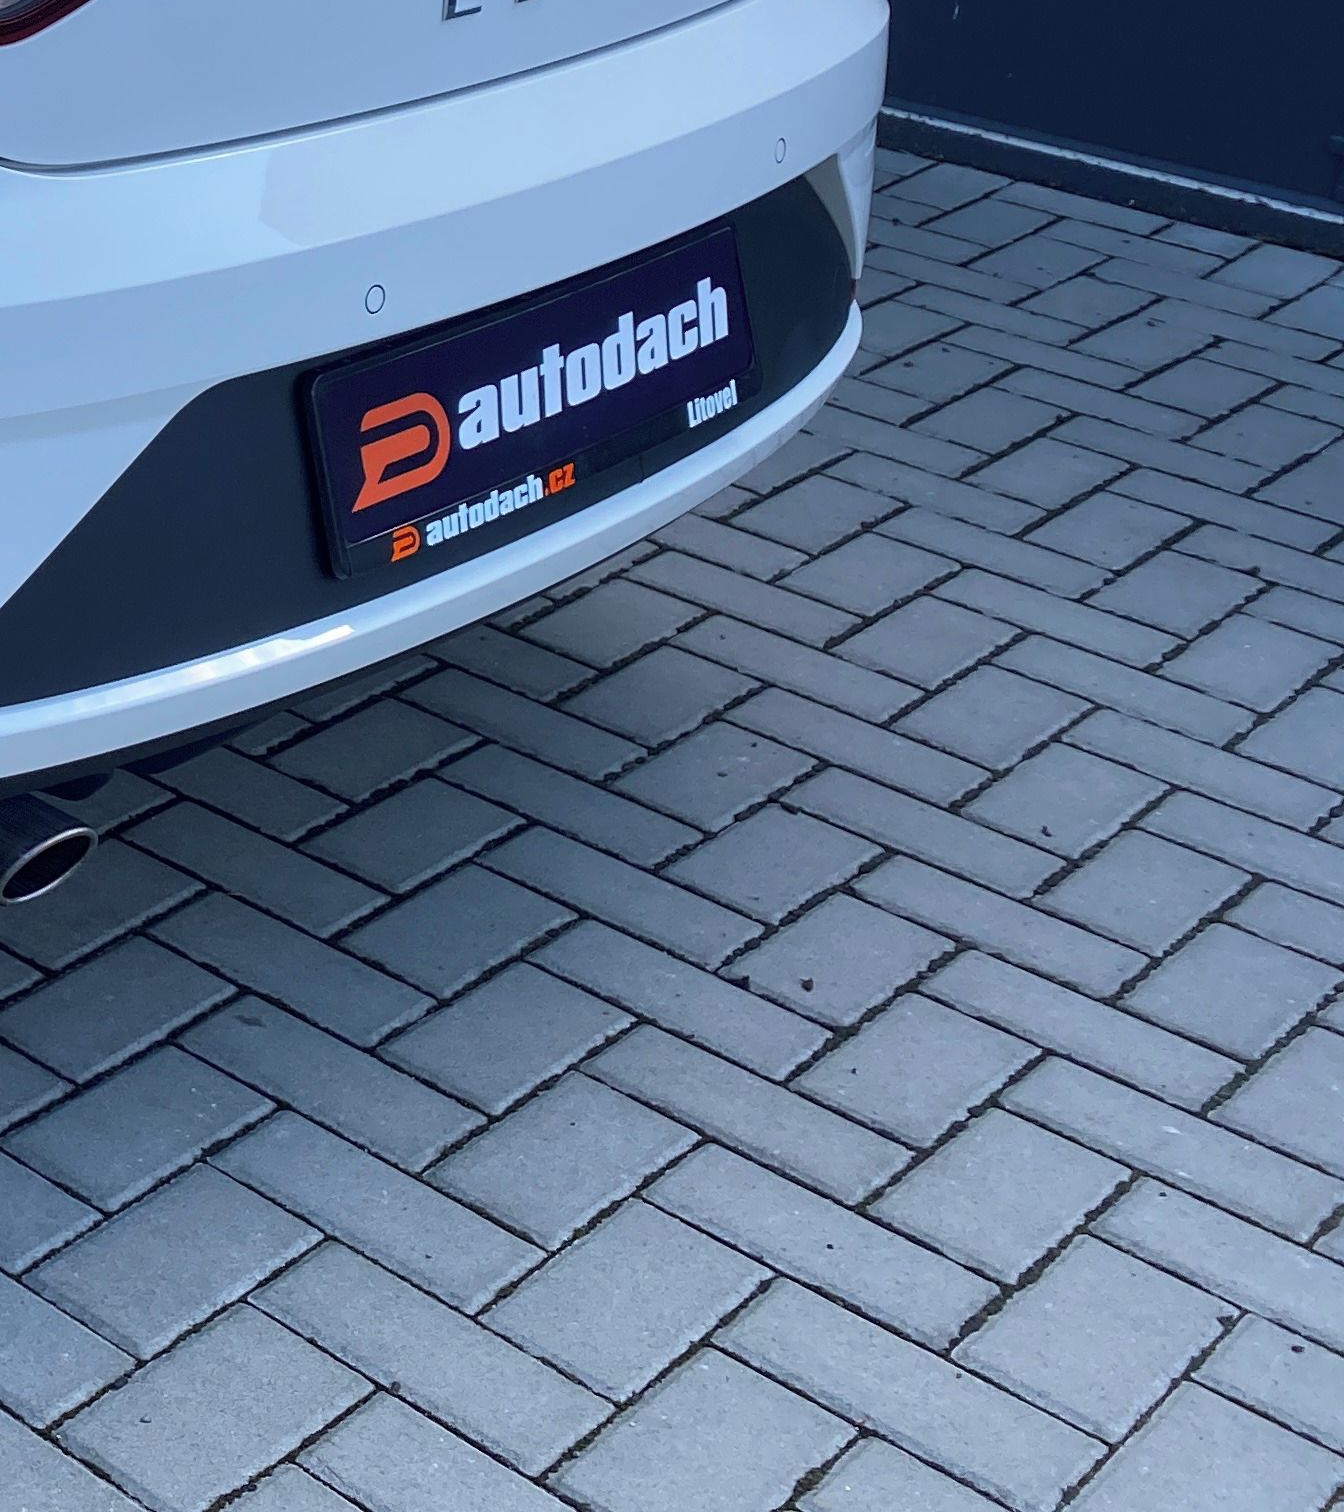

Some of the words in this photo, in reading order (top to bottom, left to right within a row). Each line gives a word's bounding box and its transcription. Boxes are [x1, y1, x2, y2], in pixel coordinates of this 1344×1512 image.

[458, 277, 729, 450] autodach
[687, 379, 738, 428] Litovel
[426, 462, 576, 546] autodach.cz
